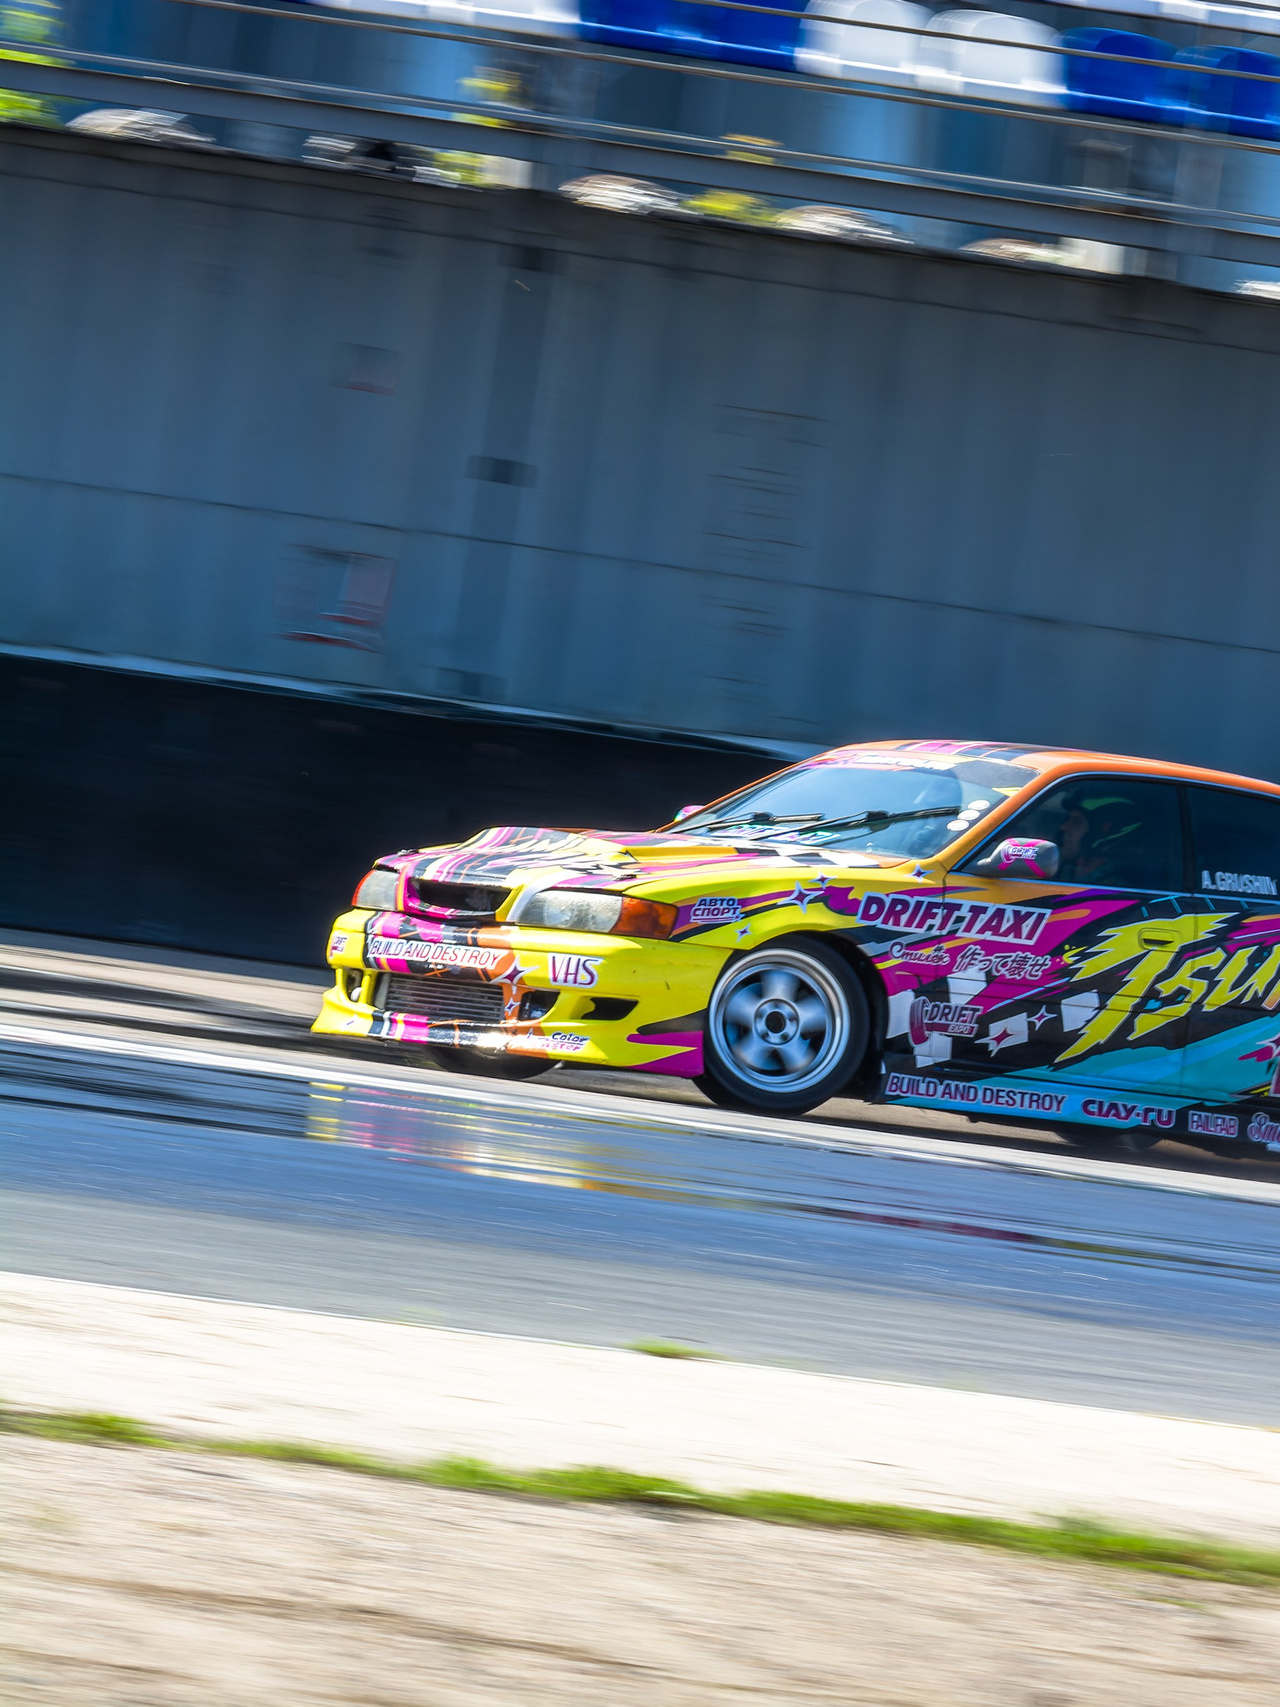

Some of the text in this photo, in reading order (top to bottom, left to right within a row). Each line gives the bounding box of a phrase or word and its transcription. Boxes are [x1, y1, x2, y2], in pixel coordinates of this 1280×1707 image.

[692, 907, 741, 917] СПОРТ
[697, 898, 736, 907] АВТО
[859, 894, 1047, 941] DRIFT TAXI
[370, 939, 501, 968] BUILD AND DESTROY
[953, 945, 1051, 979] 作って壊せ
[551, 955, 600, 986] VHS
[927, 1003, 981, 1024] DRIFT
[551, 1031, 590, 1043] Color
[888, 1075, 1067, 1113] BUILD AND DESTROY
